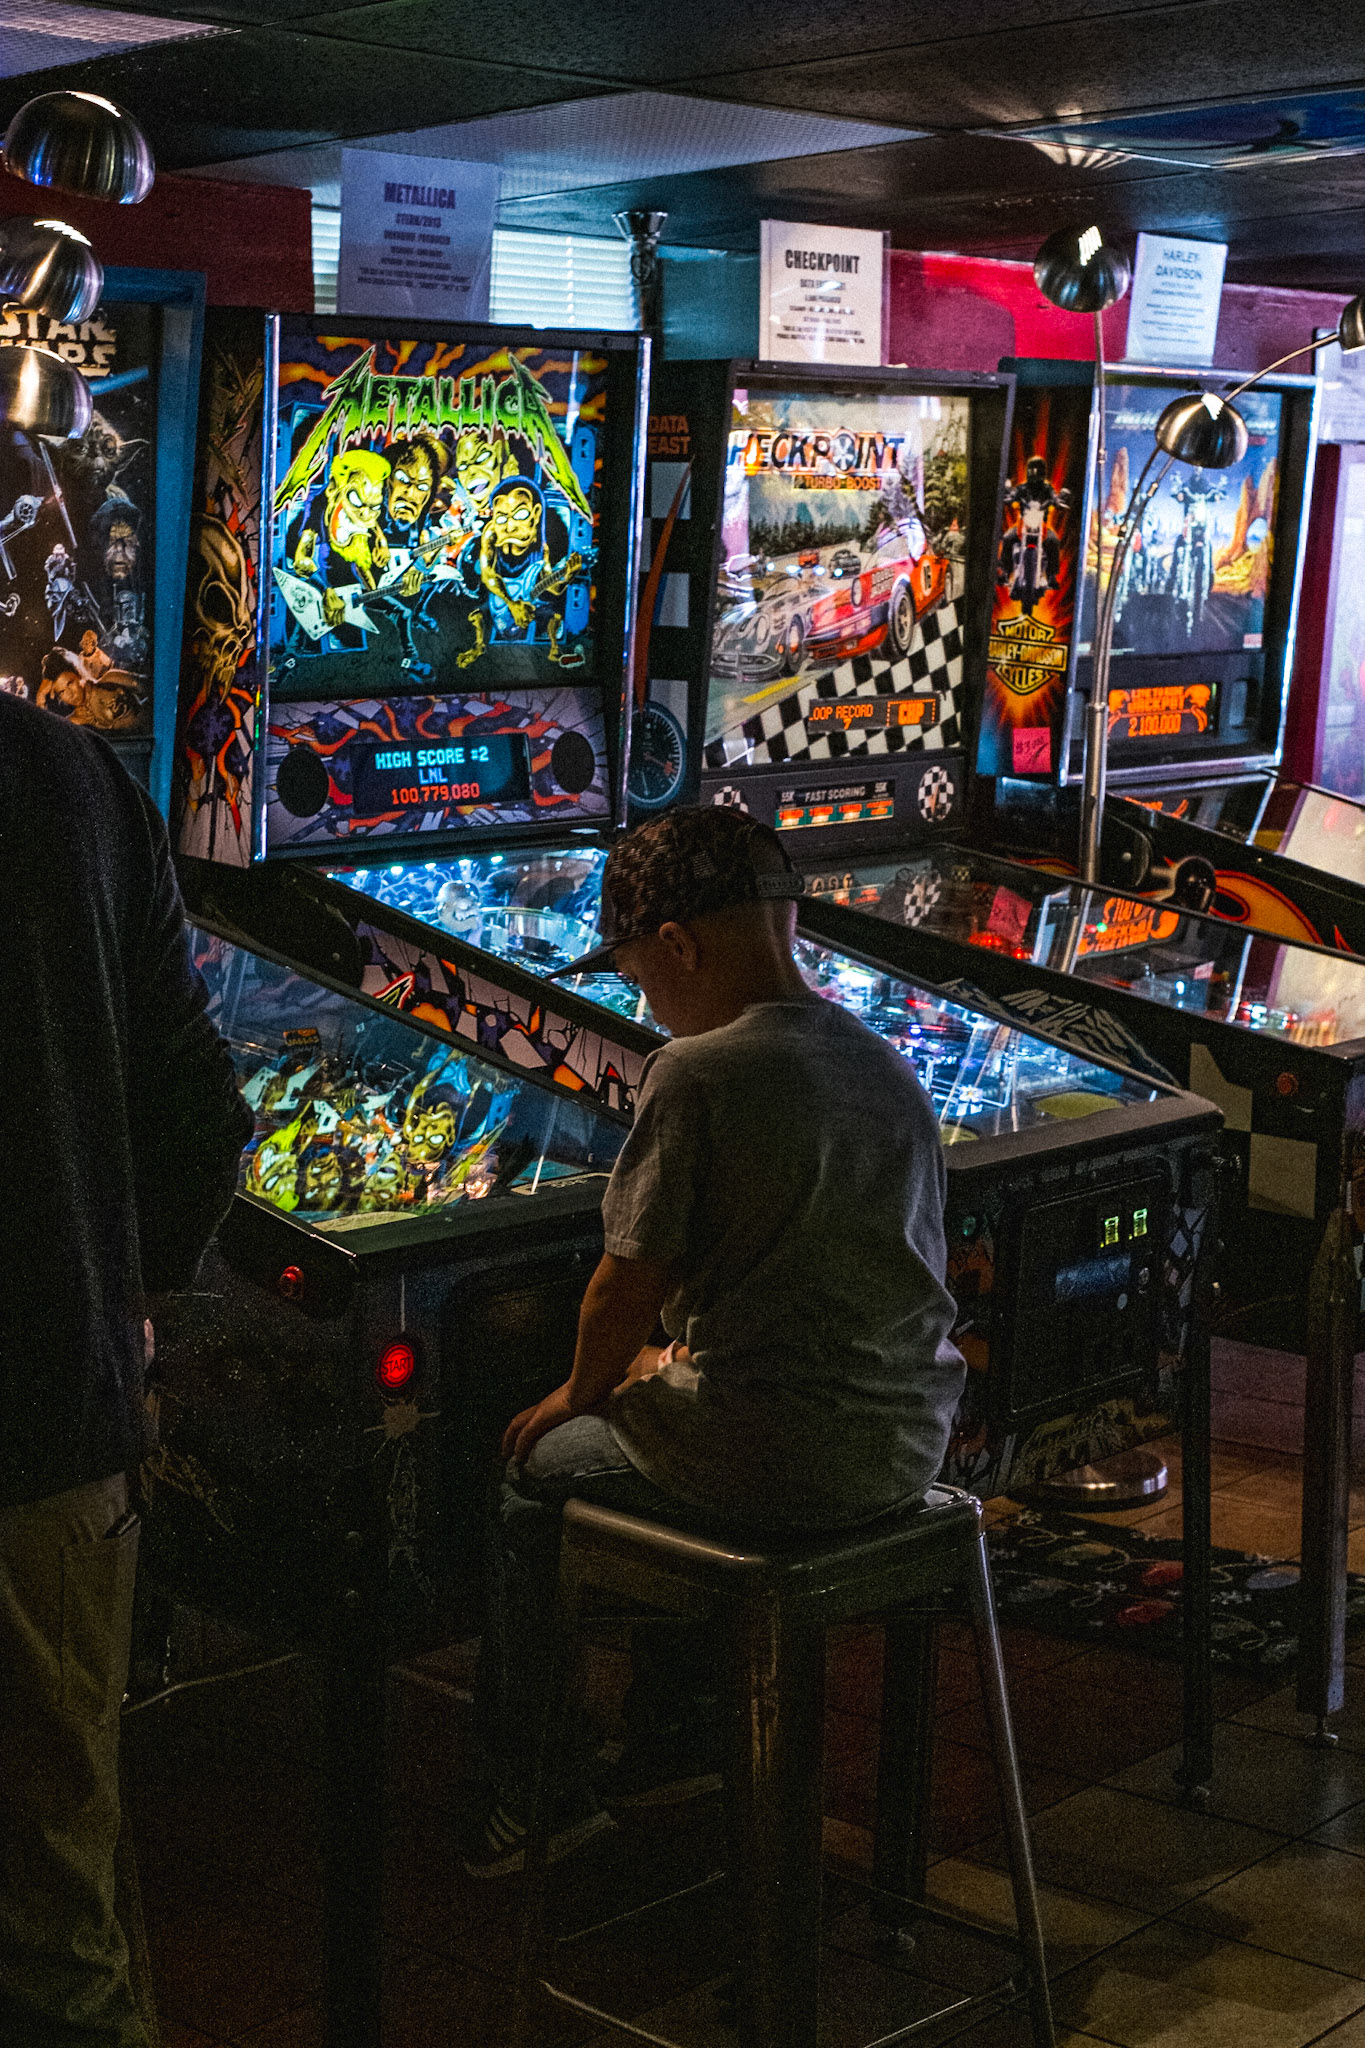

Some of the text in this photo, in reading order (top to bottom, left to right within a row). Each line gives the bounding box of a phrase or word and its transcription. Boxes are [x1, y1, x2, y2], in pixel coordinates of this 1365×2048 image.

[384, 182, 456, 209] METALLICA
[785, 249, 860, 274] CHECKPOINT
[648, 415, 689, 434] DATA
[648, 435, 691, 455] EAST
[1002, 664, 1043, 689] CYCLES
[835, 703, 874, 719] RECORD
[375, 751, 412, 770] HIGH
[416, 748, 465, 767] SCORE
[418, 767, 449, 785] LNL
[391, 782, 480, 805] 100,779,080
[805, 789, 827, 803] FAST
[828, 786, 866, 800] SCORING
[382, 1356, 413, 1376] START
